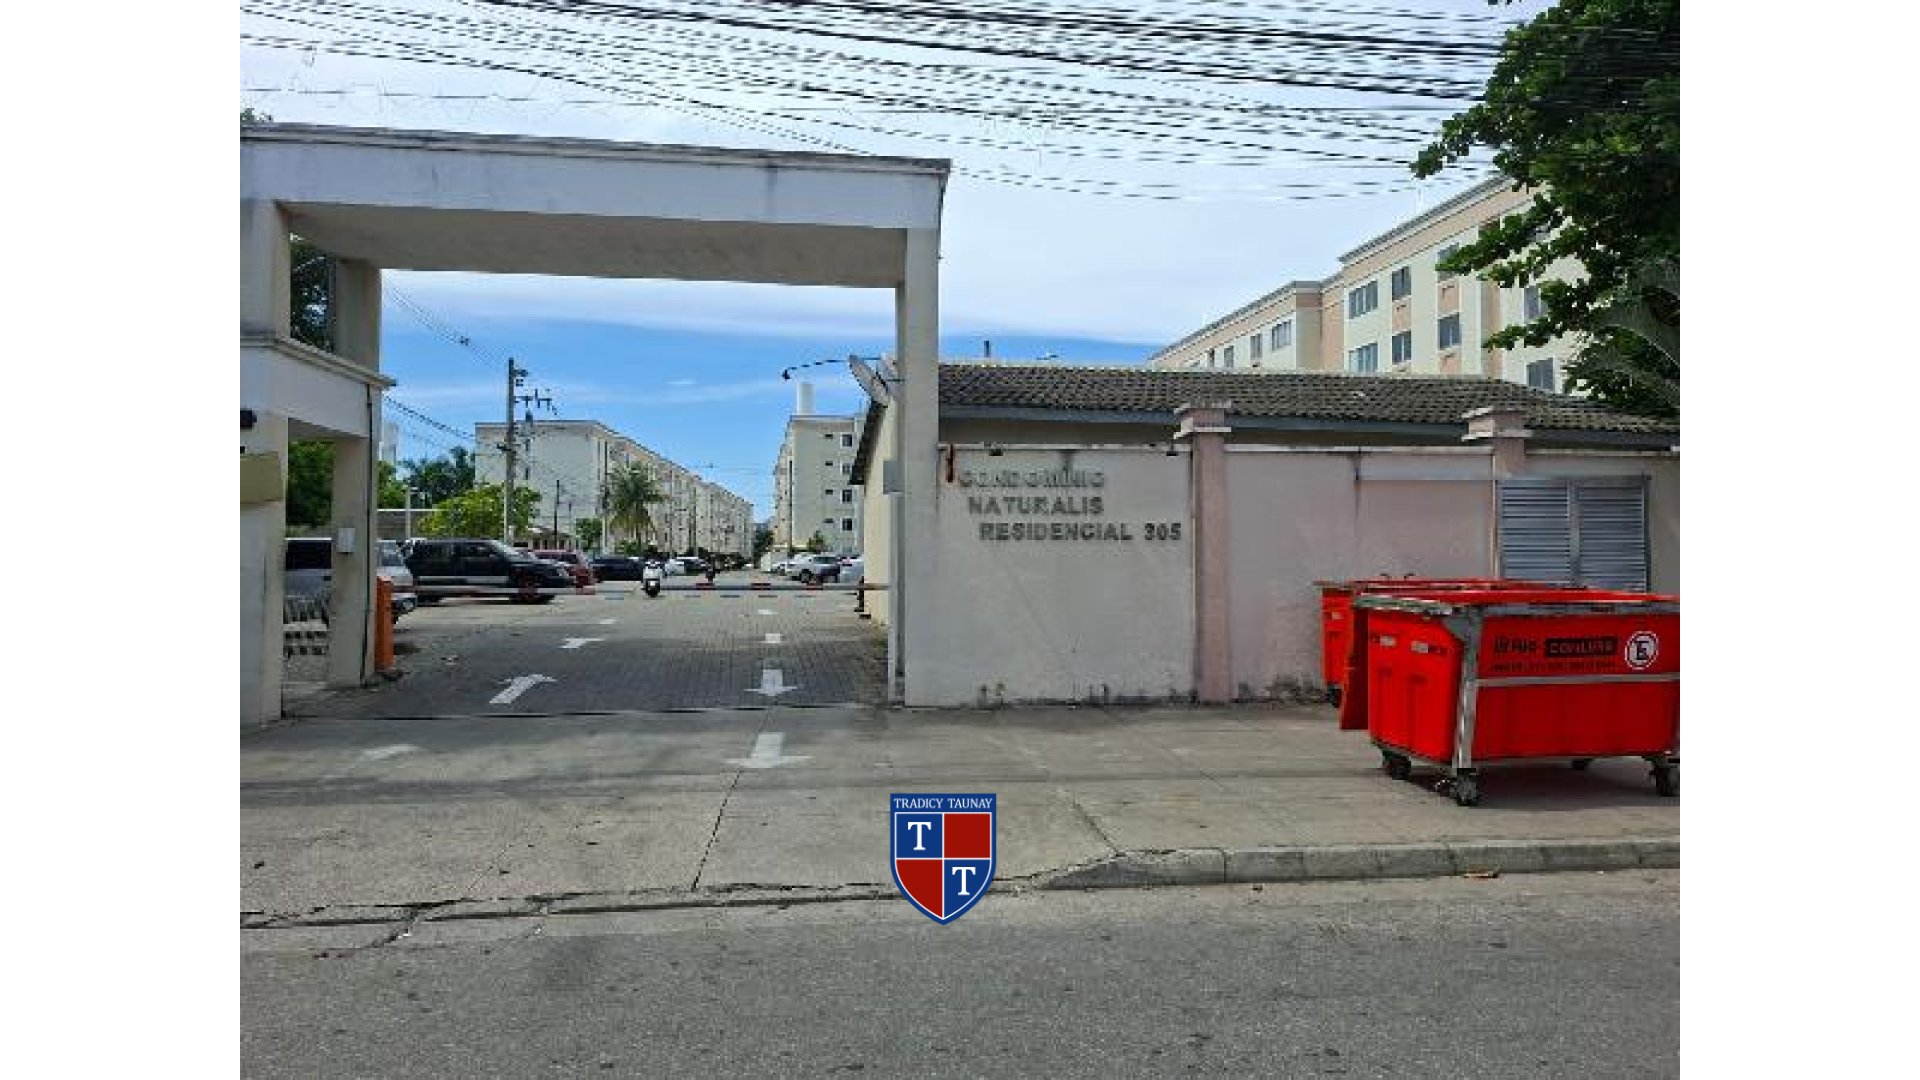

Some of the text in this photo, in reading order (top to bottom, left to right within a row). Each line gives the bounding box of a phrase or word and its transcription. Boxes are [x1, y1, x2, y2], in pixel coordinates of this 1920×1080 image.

[968, 496, 1105, 515] NATURALIS
[979, 522, 1182, 542] RESIDENCIAL 305
